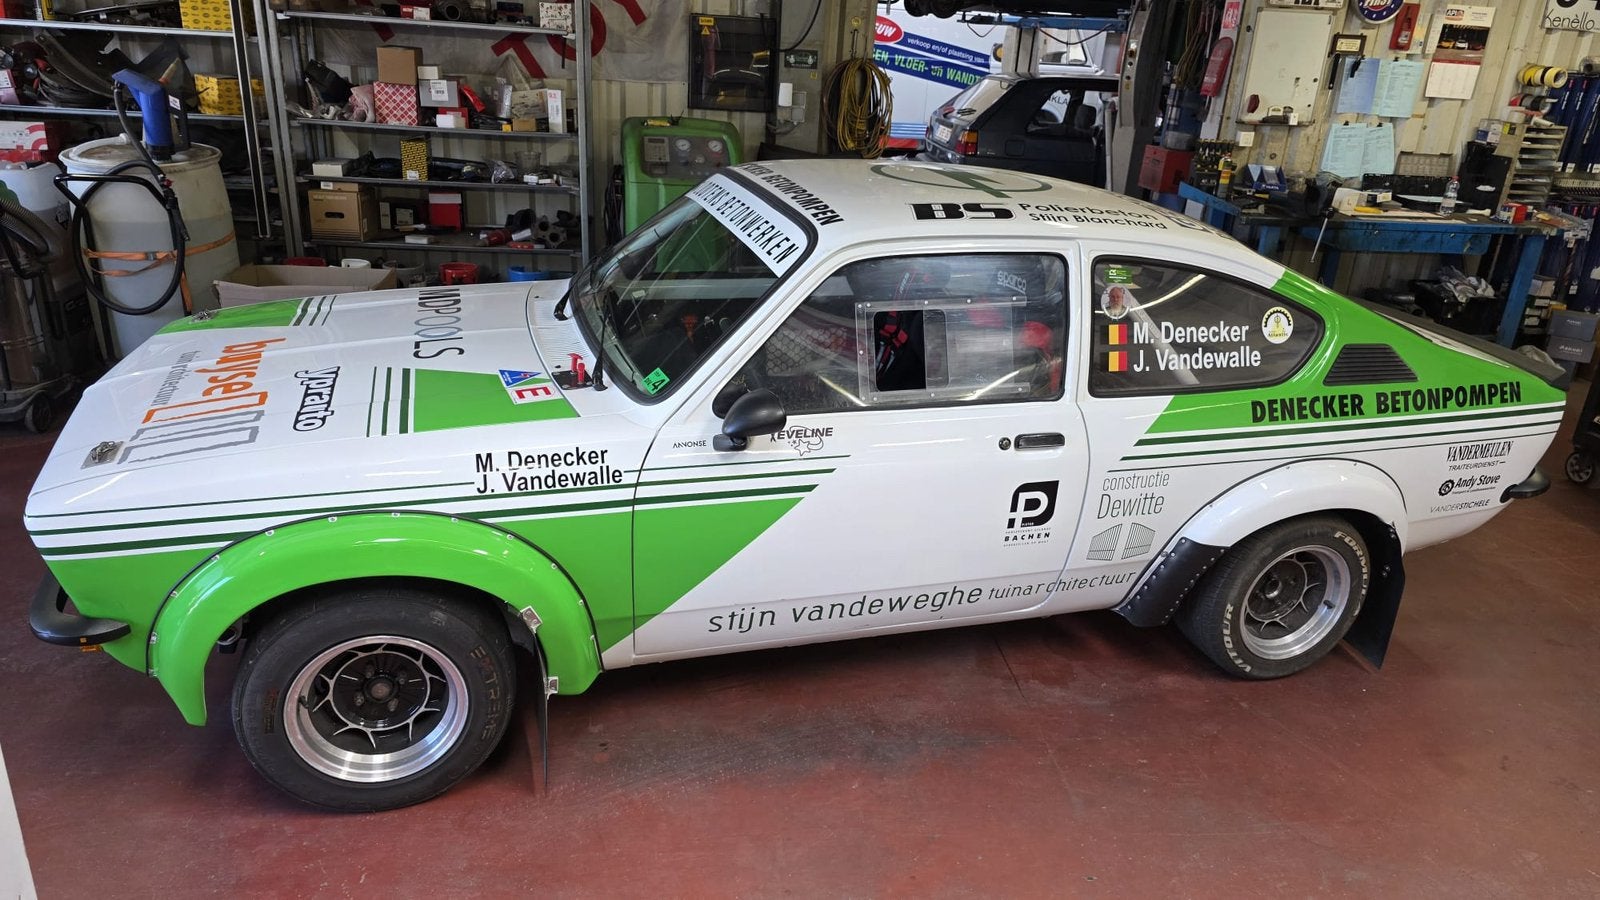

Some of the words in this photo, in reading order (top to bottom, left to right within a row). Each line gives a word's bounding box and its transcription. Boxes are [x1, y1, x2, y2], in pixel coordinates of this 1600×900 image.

[907, 38, 931, 50] verkoop
[932, 44, 948, 54] en/of
[948, 48, 974, 63] plaatsing
[895, 54, 929, 73] VLOER-
[911, 203, 1015, 221] BS
[1019, 203, 1158, 221] Polierbeton
[1029, 212, 1072, 225] Stijn
[1073, 214, 1168, 230] Blanchard
[716, 196, 799, 264] BETONWERKEN
[413, 288, 465, 360] MDPOOLS
[1133, 322, 1155, 344] M.
[1160, 320, 1249, 344] Denecker
[1133, 349, 1150, 373] J.
[1156, 345, 1261, 371] Vandewalle
[1251, 393, 1365, 424] DENECKER
[1376, 381, 1522, 415] BETONPOMPEN
[475, 452, 500, 473] M.
[507, 446, 608, 471] Denecker
[1447, 440, 1514, 462] VANDERMEULEN
[1448, 460, 1500, 471] TRAITEURDIENST
[476, 474, 496, 495] J.
[501, 466, 623, 493] Vandewalle
[1103, 472, 1170, 492] constructie
[1455, 475, 1479, 489] Andy
[1476, 474, 1501, 486] Stove
[1097, 493, 1165, 520] Dewitte
[1004, 531, 1051, 542] BACHEN
[708, 607, 776, 634] stijn
[791, 585, 983, 624] vandeweghe
[988, 569, 1137, 601] tuinarchitectuur
